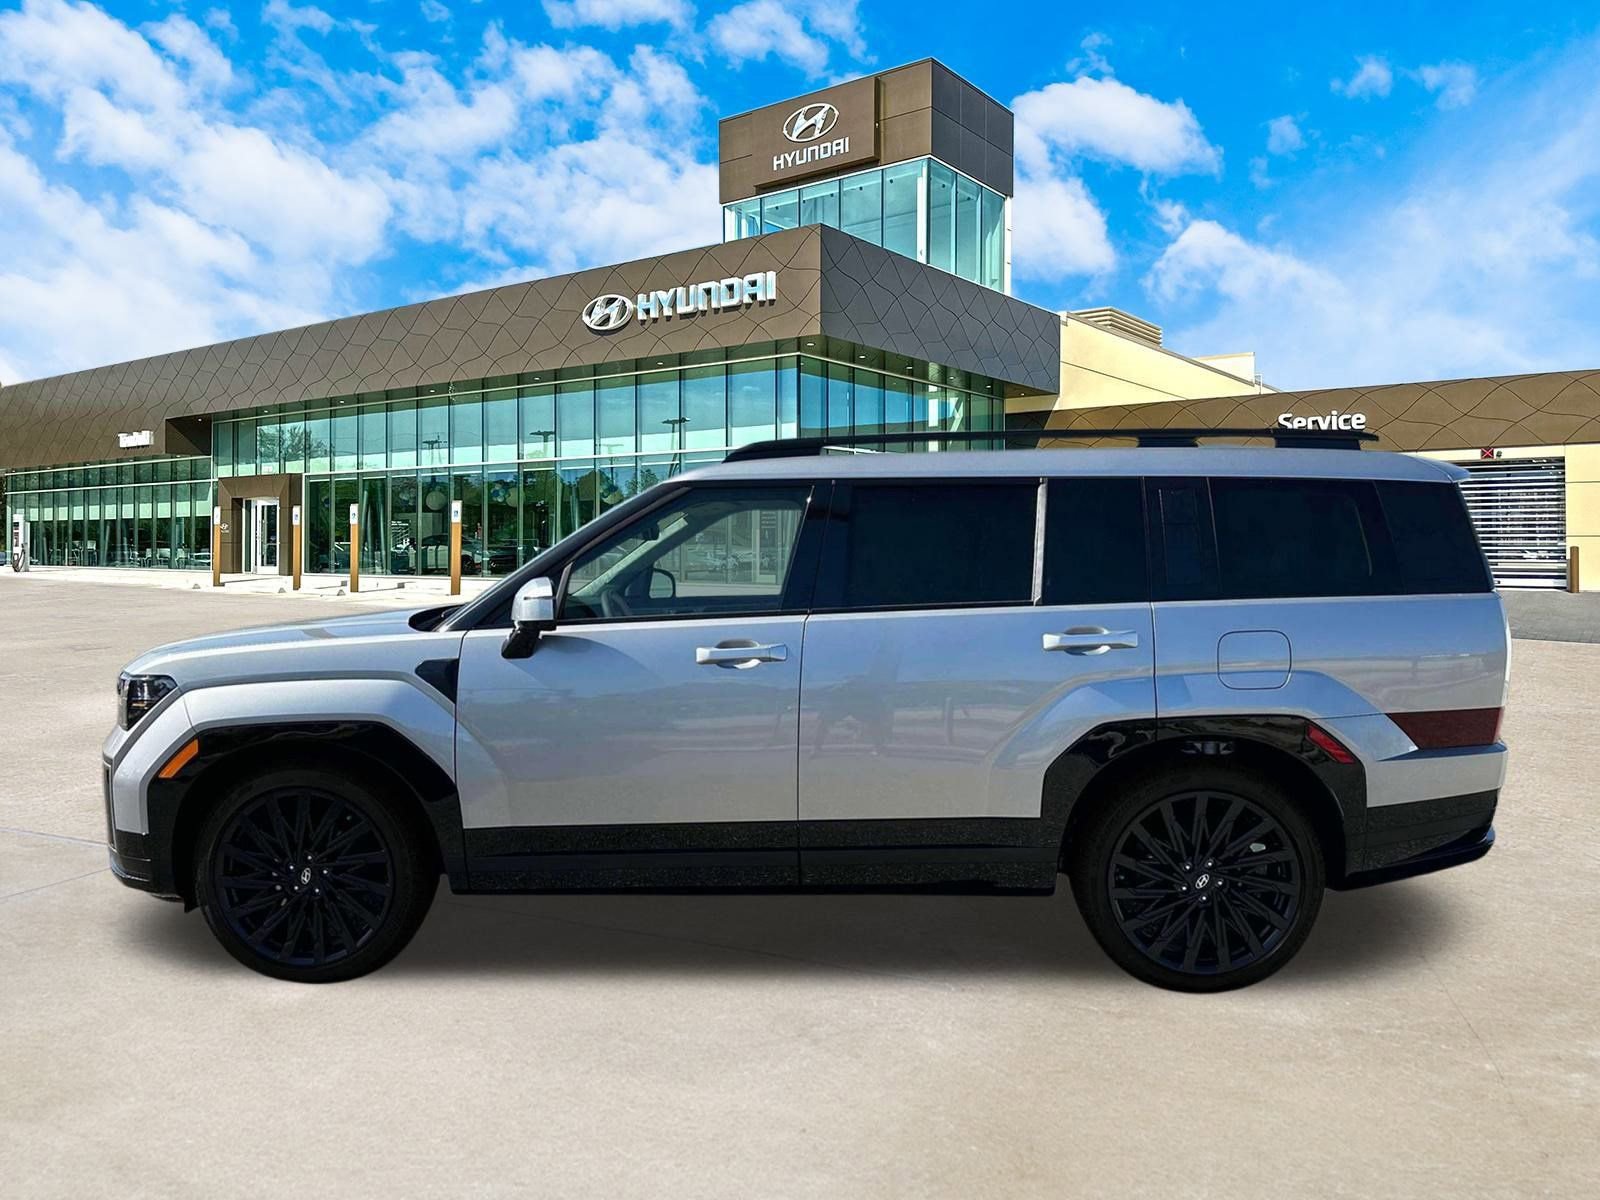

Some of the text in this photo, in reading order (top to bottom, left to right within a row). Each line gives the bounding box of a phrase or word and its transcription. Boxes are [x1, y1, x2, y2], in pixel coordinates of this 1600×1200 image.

[773, 136, 849, 171] HYUNDAI
[636, 270, 777, 320] HYUNDAI
[1278, 410, 1366, 430] Service
